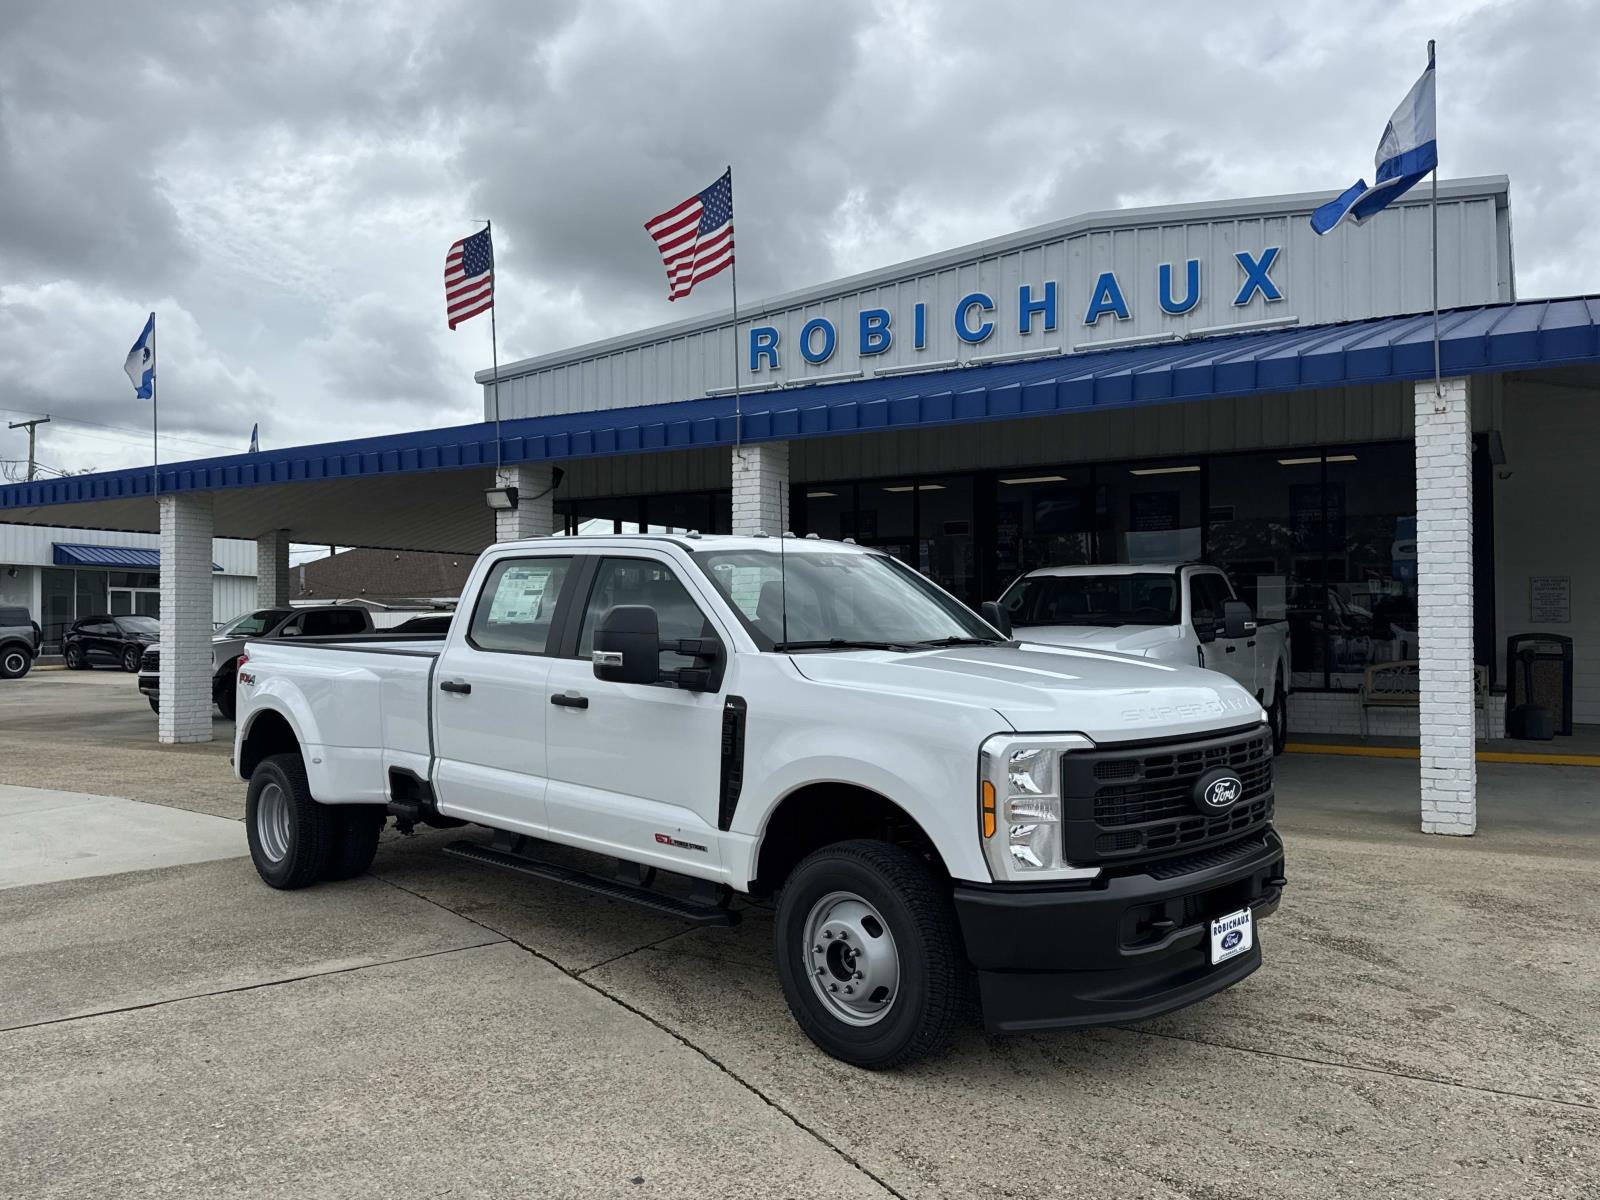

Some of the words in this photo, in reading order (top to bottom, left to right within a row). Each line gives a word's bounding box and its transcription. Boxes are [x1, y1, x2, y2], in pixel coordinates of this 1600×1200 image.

[749, 246, 1284, 372] ROBICHAUX
[1122, 702, 1203, 721] SUPER
[1211, 780, 1237, 804] Ford
[1213, 914, 1249, 936] ROBICHAUX
[1224, 931, 1240, 948] Ford
